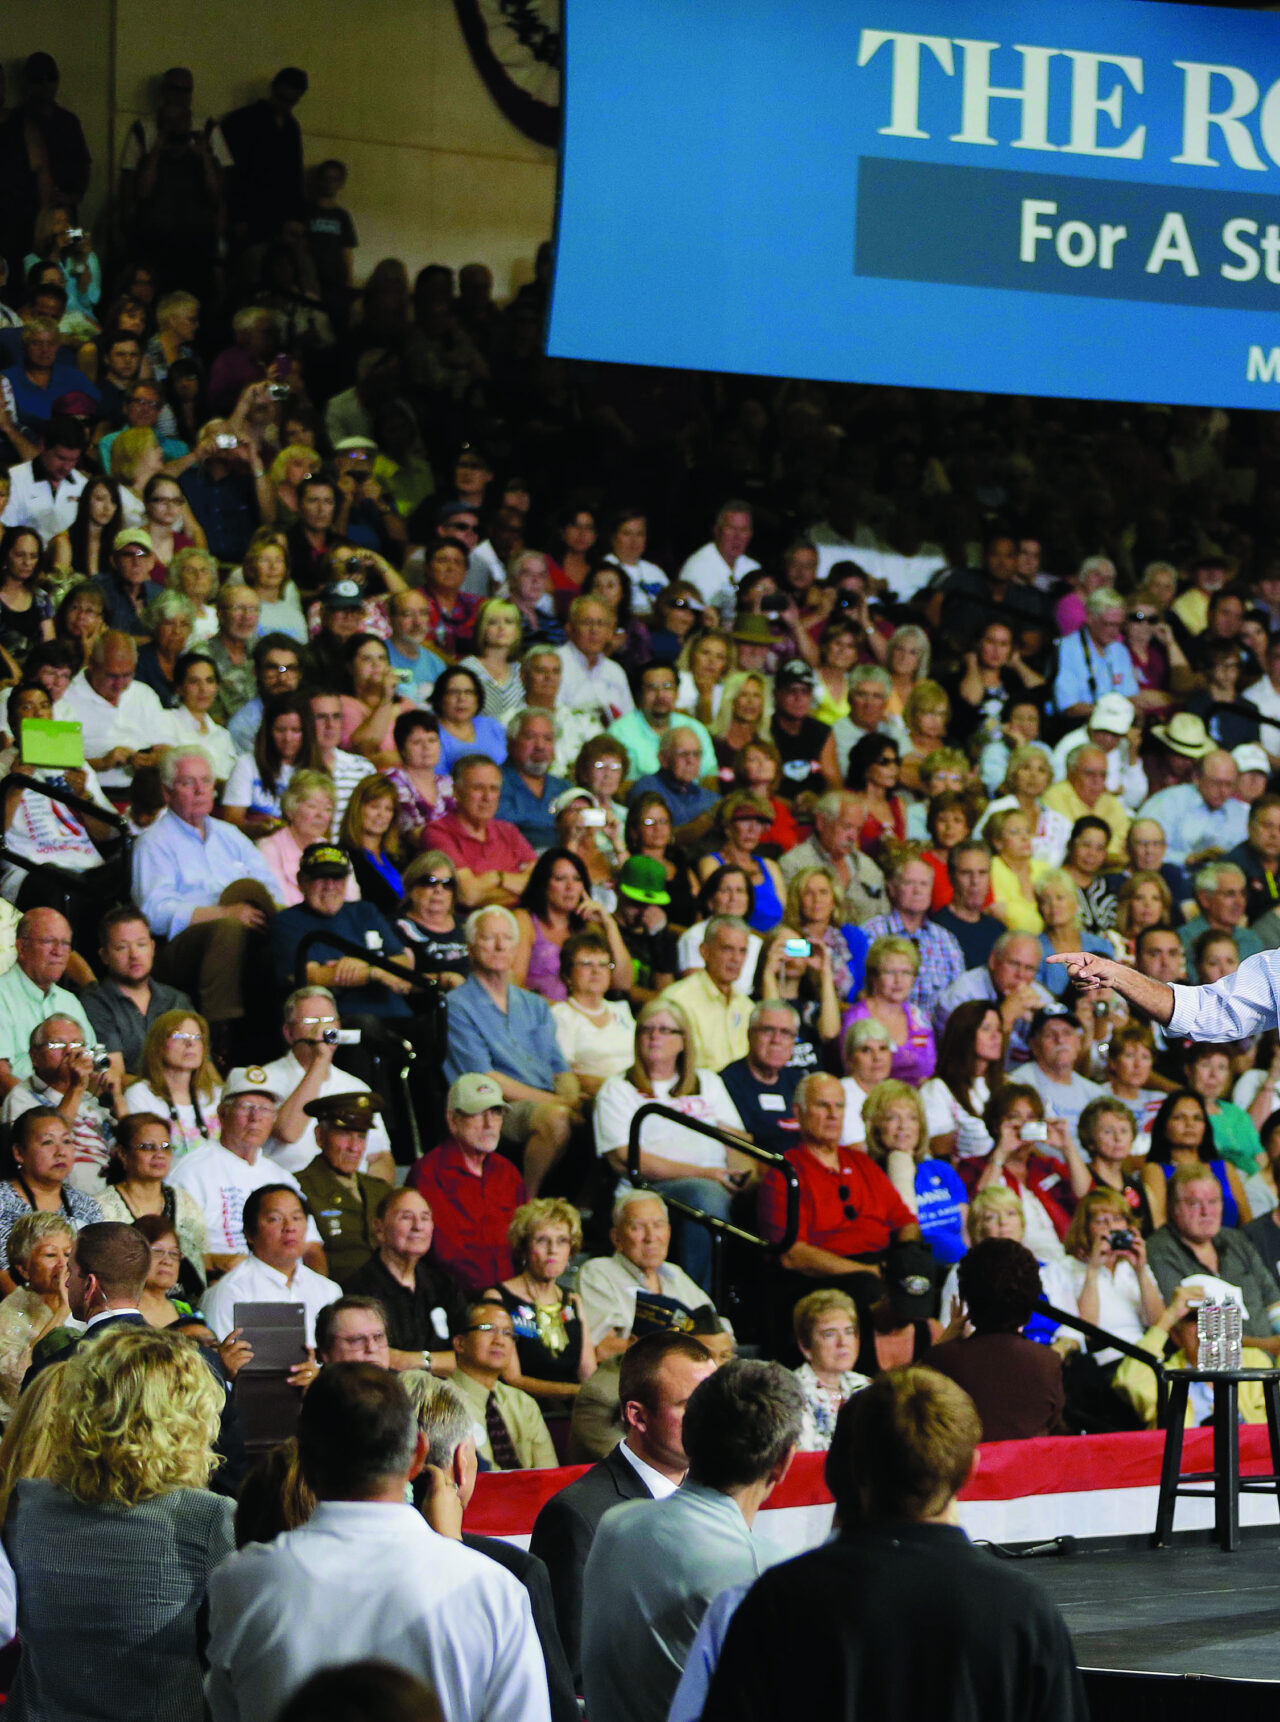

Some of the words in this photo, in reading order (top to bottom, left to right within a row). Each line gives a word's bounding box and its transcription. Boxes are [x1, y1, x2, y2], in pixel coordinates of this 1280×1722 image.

[857, 28, 1147, 160] THE
[1020, 199, 1127, 270] For
[1146, 212, 1200, 277] A
